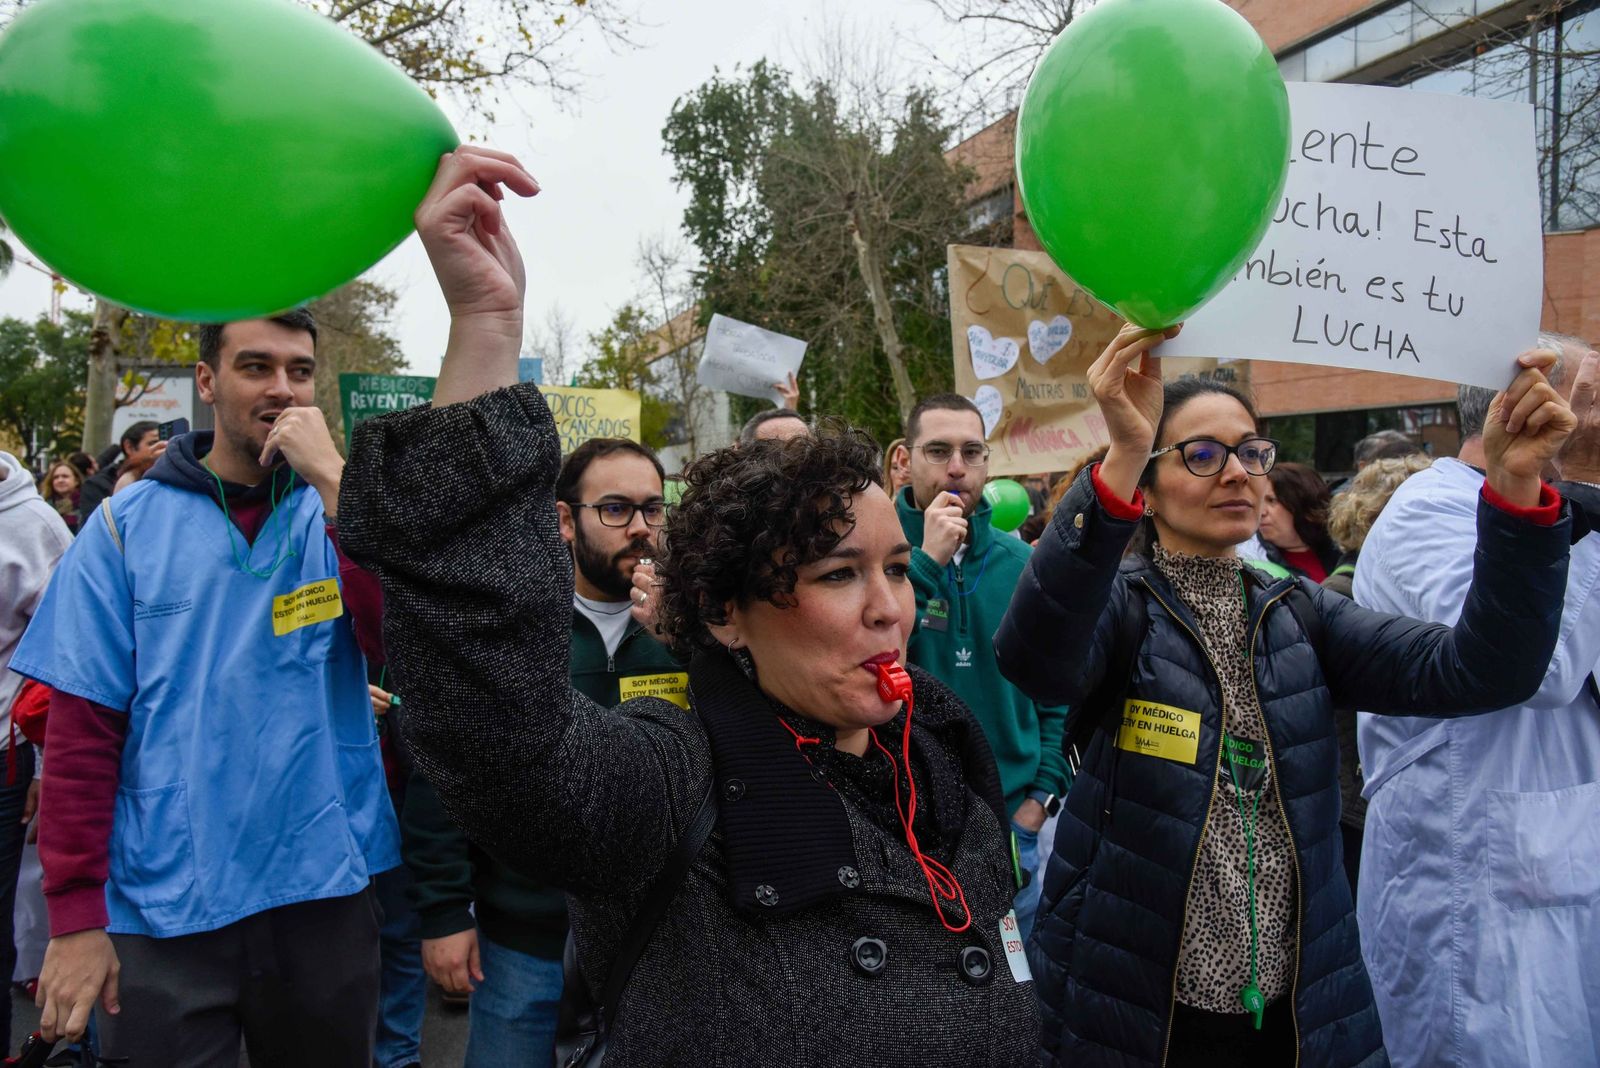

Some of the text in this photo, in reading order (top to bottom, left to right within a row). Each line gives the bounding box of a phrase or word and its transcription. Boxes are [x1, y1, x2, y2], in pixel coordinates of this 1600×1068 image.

[1289, 121, 1426, 176] ente
[1272, 192, 1498, 264] ucha! Esta
[1233, 249, 1465, 317] mbién es tu
[1291, 305, 1421, 363] LUCHA
[544, 393, 597, 418] DICOS
[306, 593, 340, 608] HUELGA
[632, 676, 679, 688] SOY MÉDICO
[622, 689, 647, 699] ESTOY
[648, 688, 660, 696] EN
[1142, 707, 1184, 722] MÉDICO
[1137, 720, 1152, 731] EN
[1153, 723, 1197, 740] HUELGA
[1227, 738, 1254, 753] DICO
